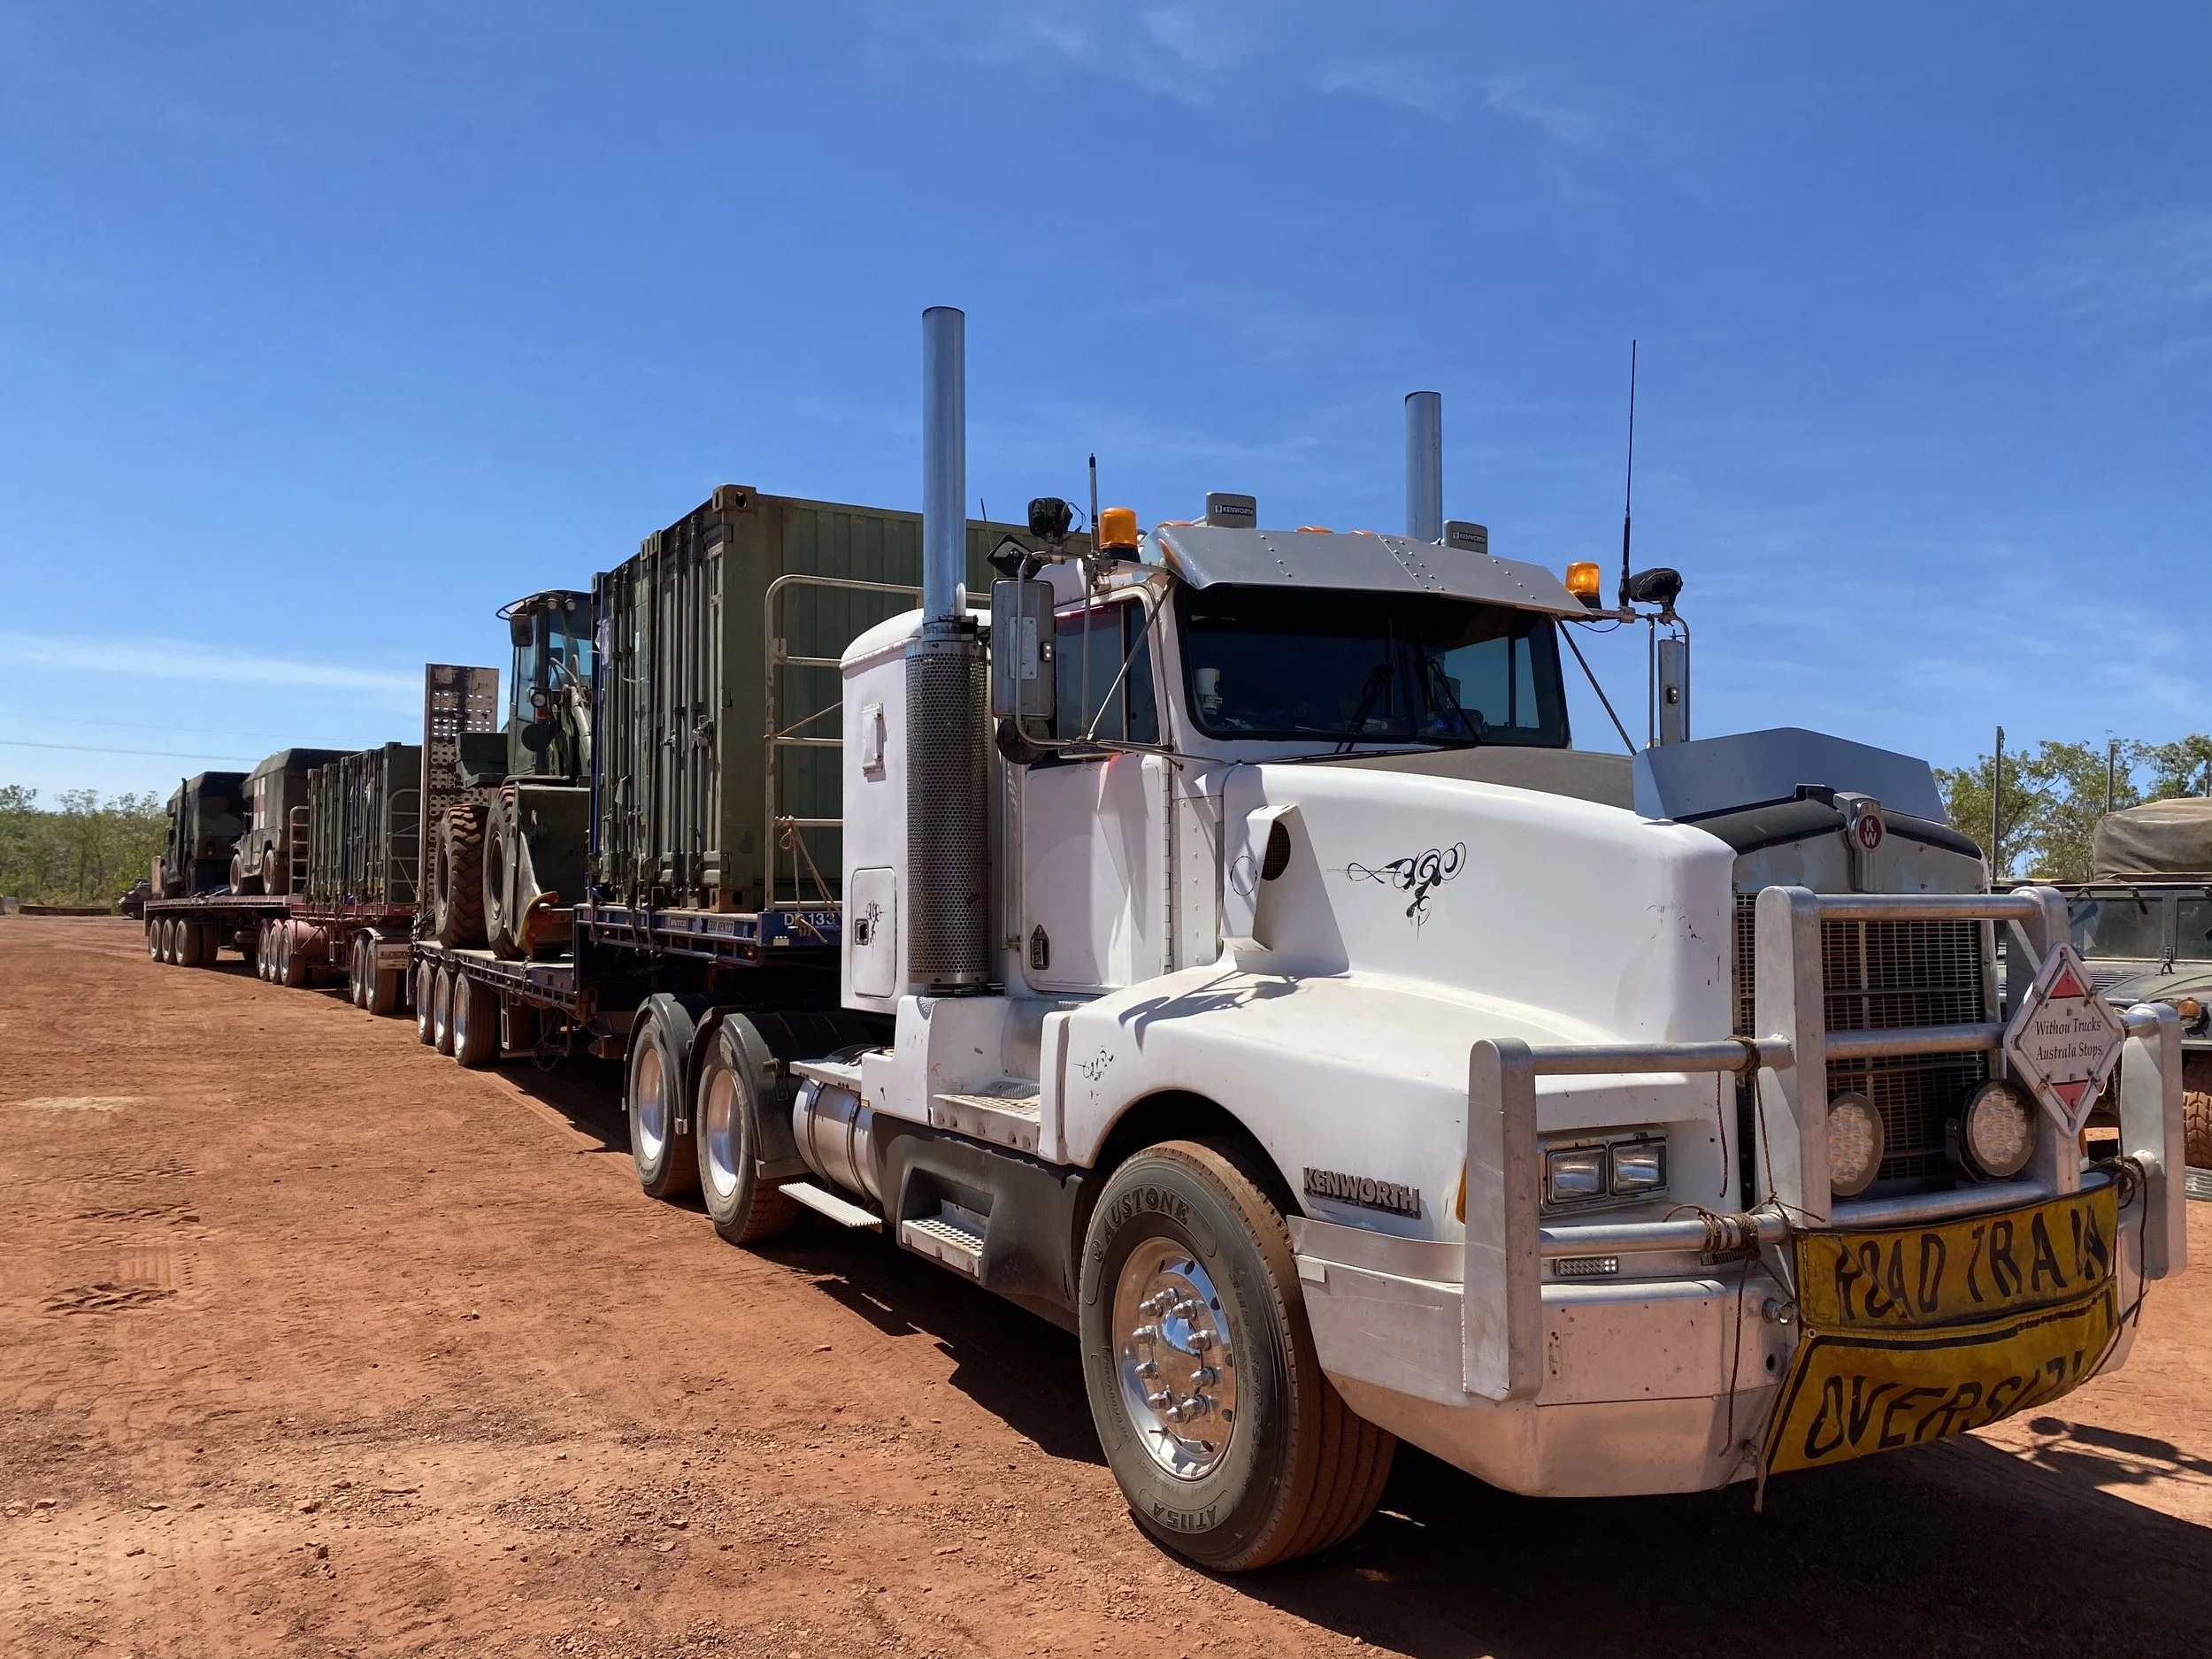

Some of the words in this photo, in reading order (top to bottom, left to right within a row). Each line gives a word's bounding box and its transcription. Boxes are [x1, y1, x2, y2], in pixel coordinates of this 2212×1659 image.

[1223, 505, 1254, 516] KENWORTH
[1459, 533, 1486, 544] KENWORTH
[2036, 1019, 2070, 1035] Withou
[2073, 1017, 2101, 1033] Trucks
[1303, 1166, 1420, 1213] KENWORTH
[1103, 1187, 1190, 1245] AUSTONE
[1836, 1233, 1946, 1320] ROAD
[1967, 1205, 2109, 1303] TRAIN
